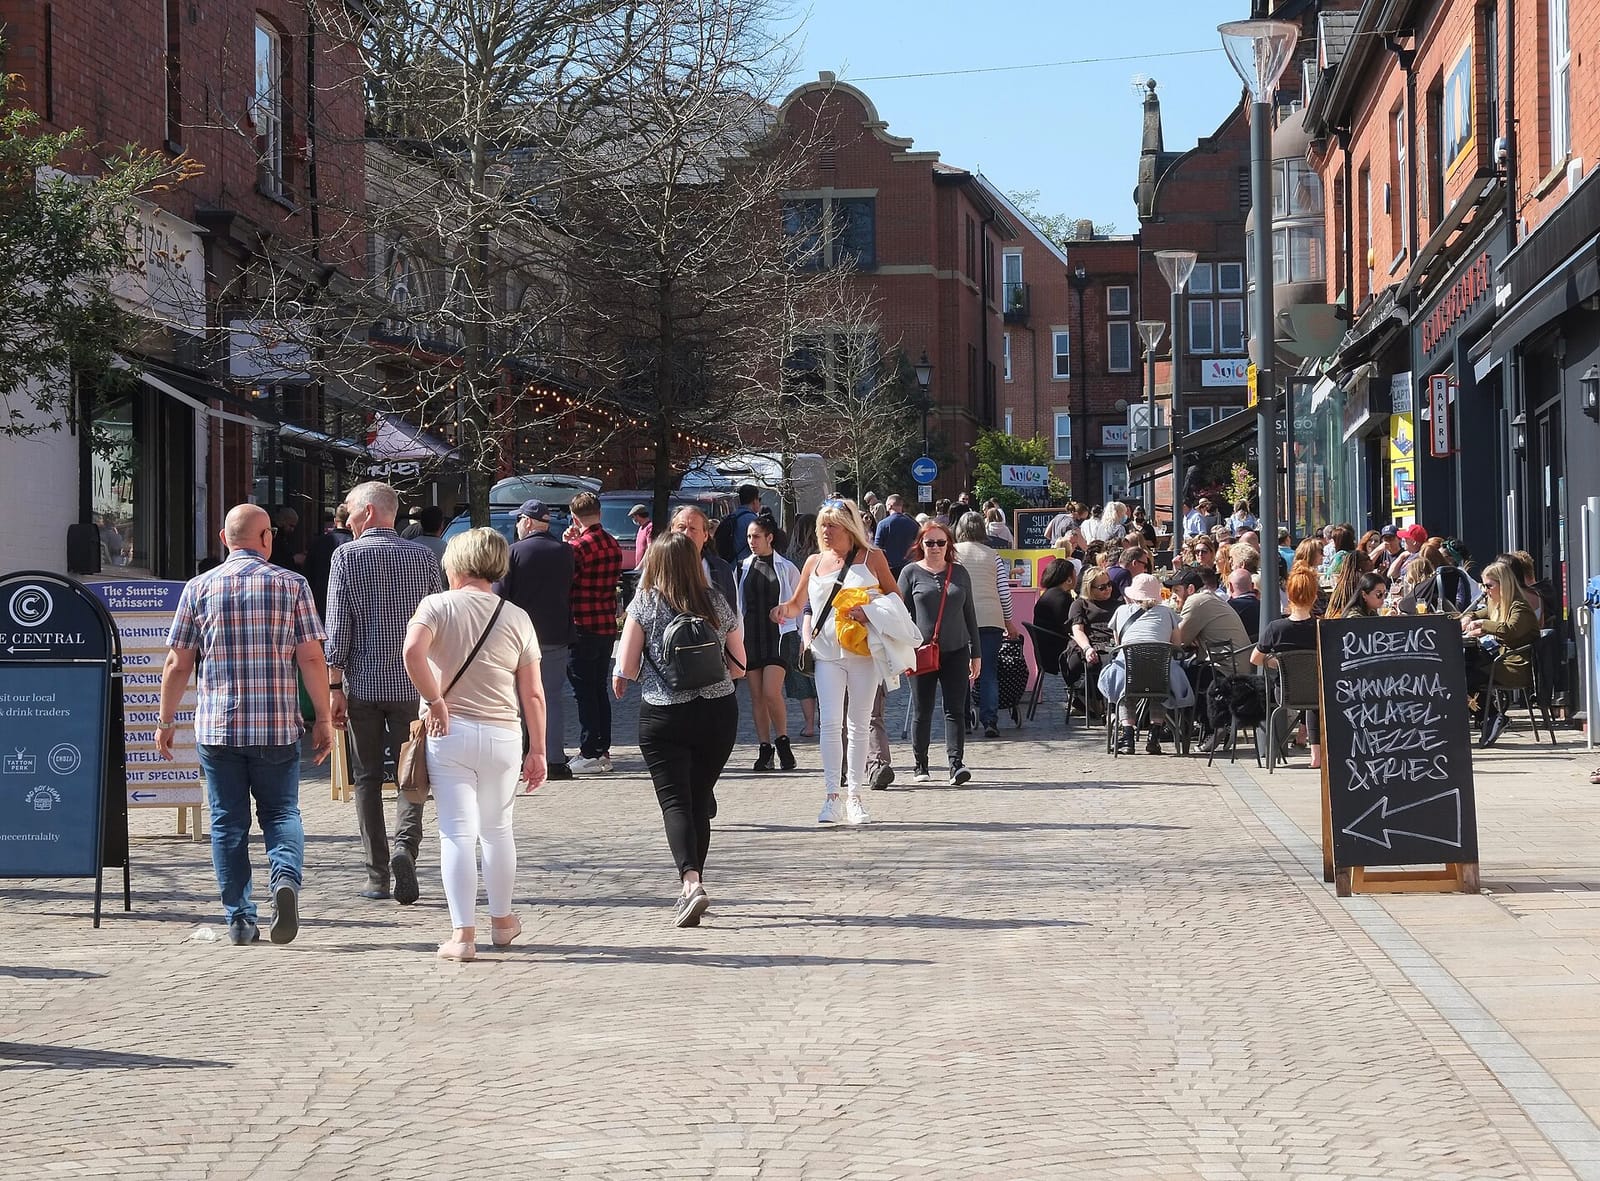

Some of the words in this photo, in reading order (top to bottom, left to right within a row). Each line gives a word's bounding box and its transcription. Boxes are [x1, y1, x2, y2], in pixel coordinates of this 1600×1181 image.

[1436, 381, 1444, 449] BAKERY
[1105, 428, 1128, 441] Juic
[1009, 467, 1040, 482] Juice
[102, 586, 122, 596] The
[126, 585, 168, 596] Sunrise
[108, 597, 164, 608] Patisserie
[12, 632, 85, 644] CENTRAL
[1342, 627, 1436, 659] RUBENS
[32, 692, 56, 702] local
[6, 707, 32, 716] drink
[36, 707, 70, 716] traders
[1352, 728, 1448, 758] MEZZE
[148, 771, 198, 781] SPECIALS
[0, 832, 60, 842] necentralalty
